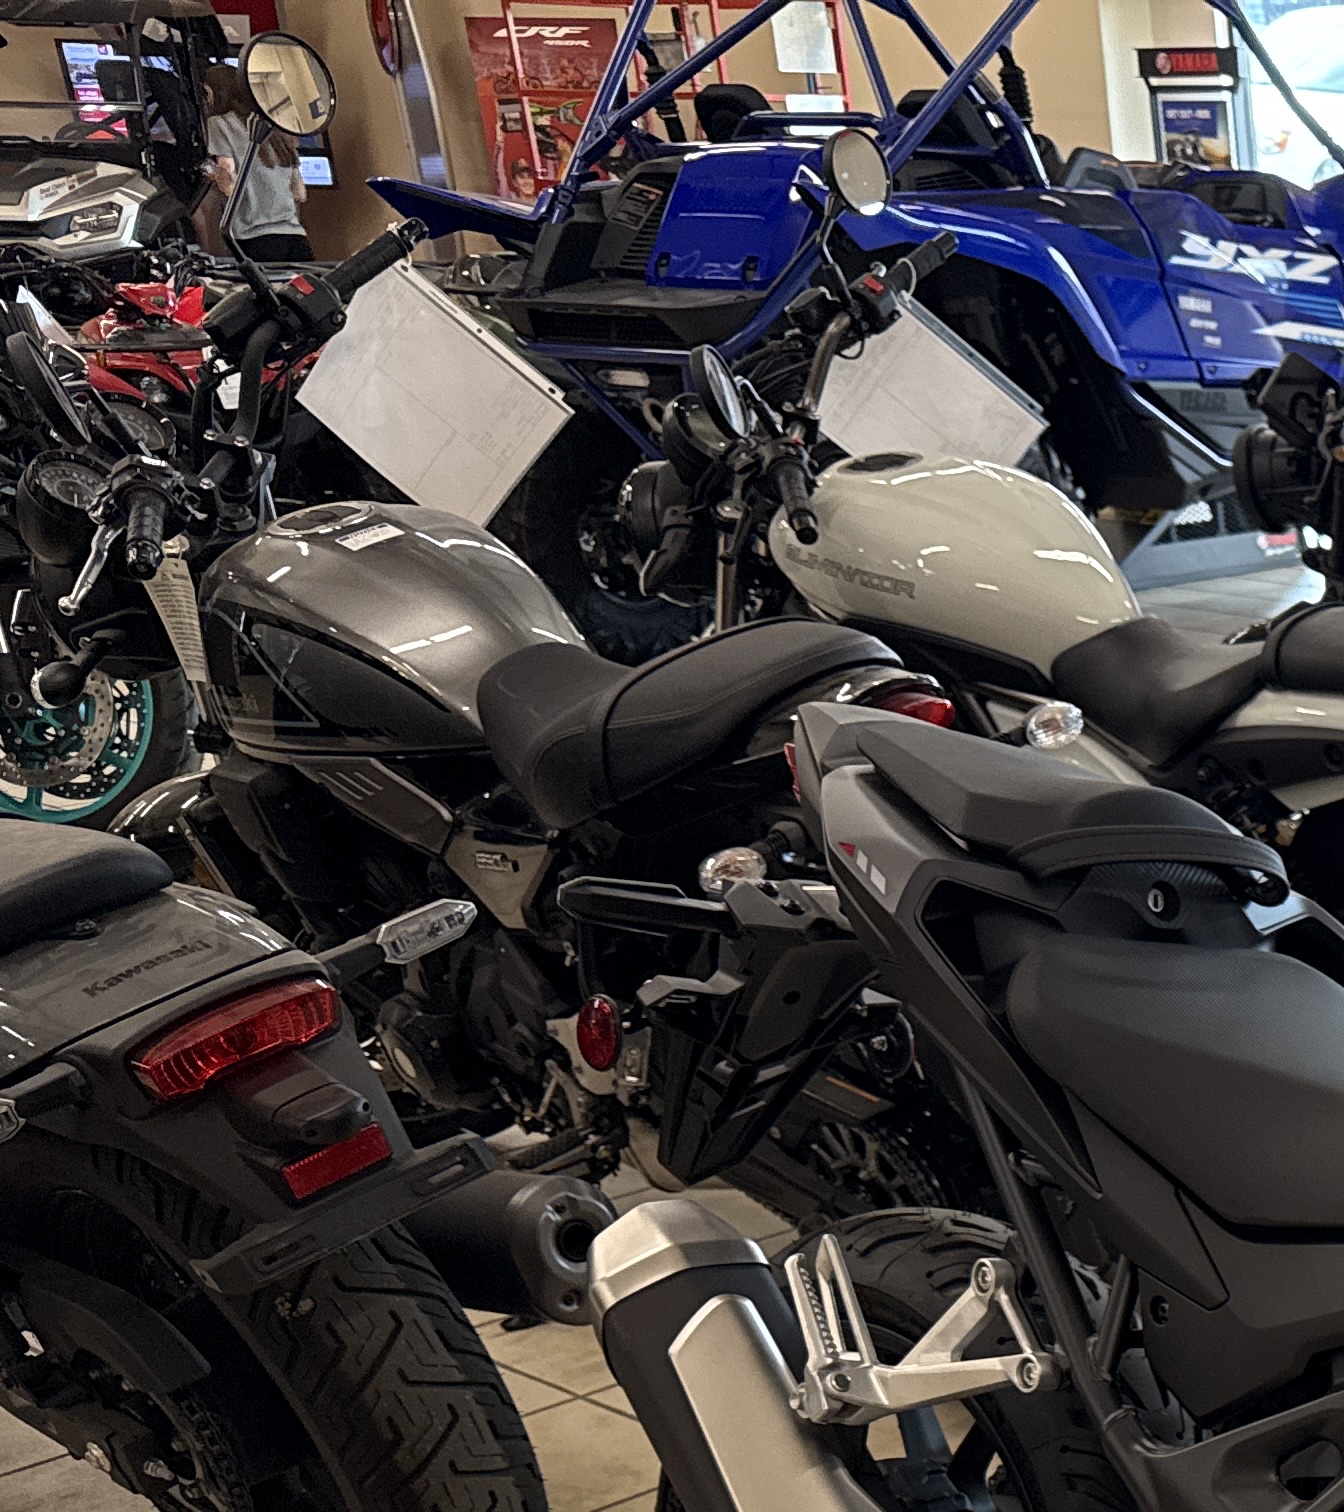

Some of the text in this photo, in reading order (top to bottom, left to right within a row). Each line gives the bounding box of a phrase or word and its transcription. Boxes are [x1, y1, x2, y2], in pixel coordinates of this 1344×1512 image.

[493, 26, 591, 38] CRF
[1169, 237, 1338, 284] YXZ
[82, 940, 213, 998] Kawasaki
